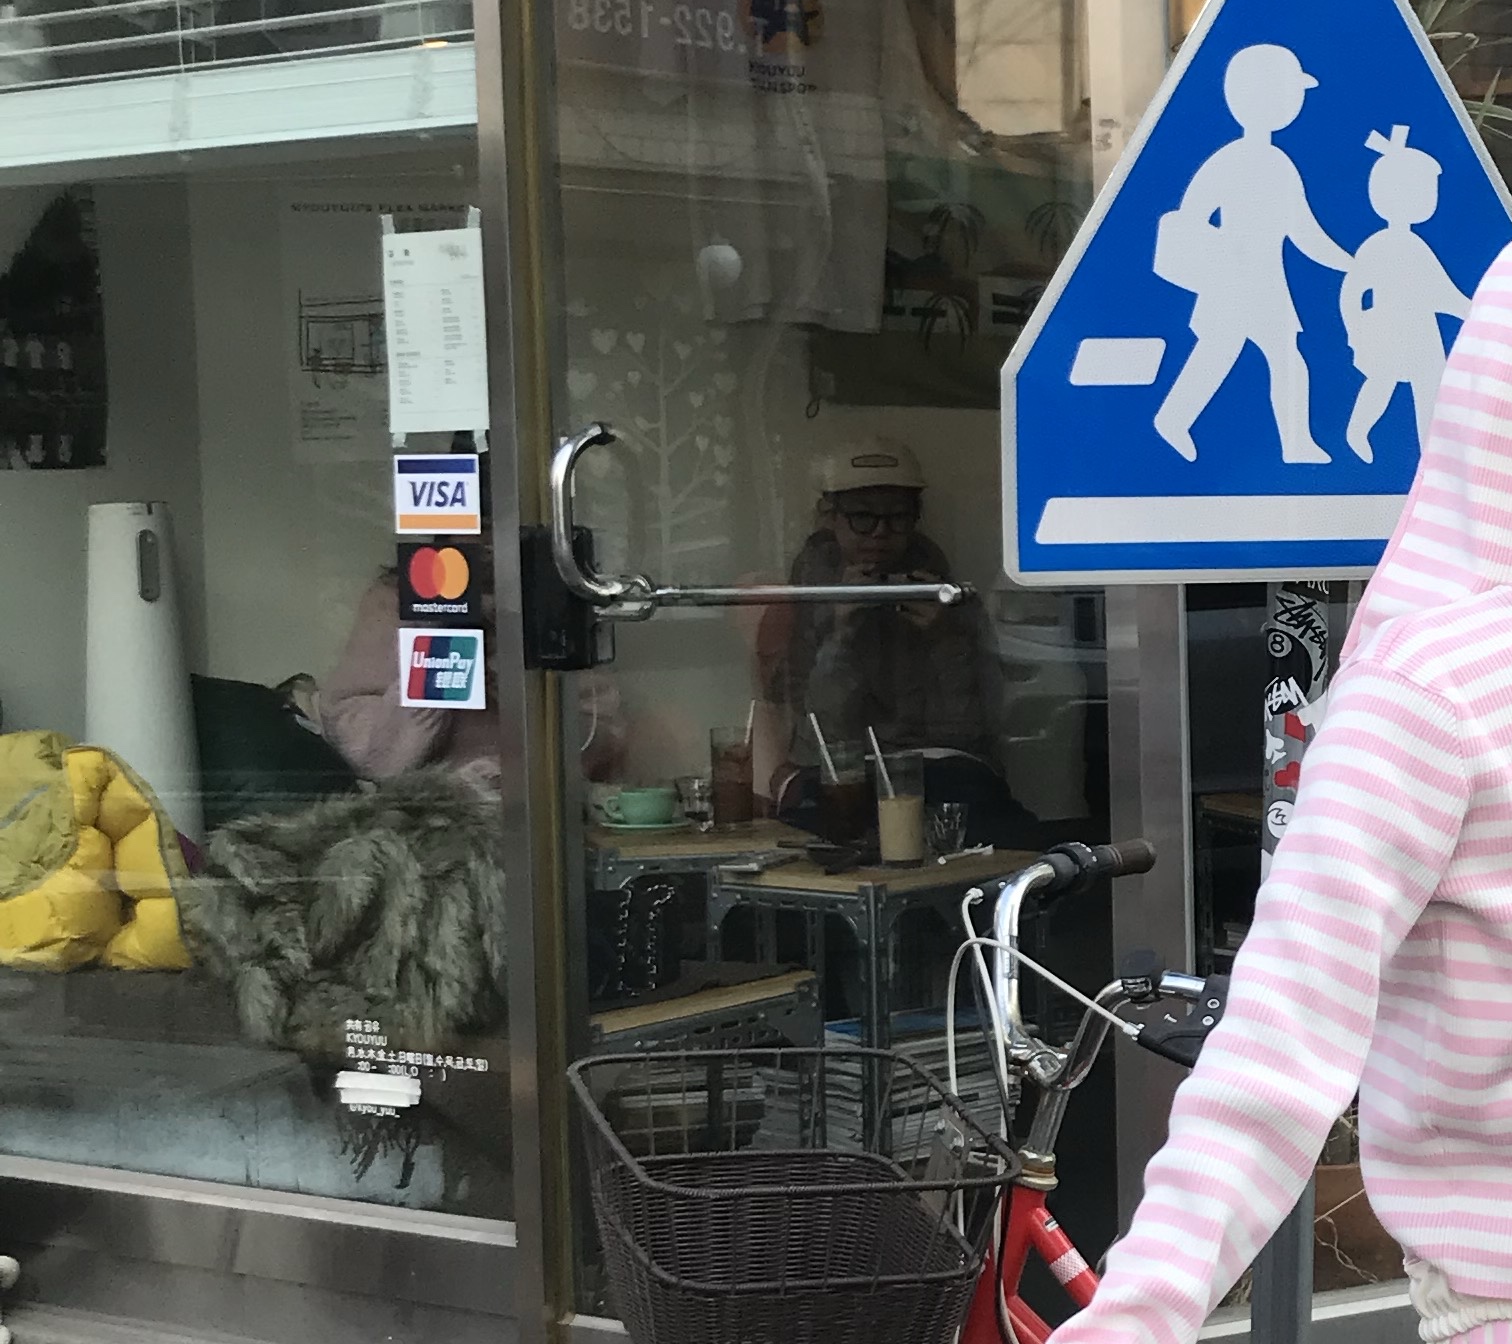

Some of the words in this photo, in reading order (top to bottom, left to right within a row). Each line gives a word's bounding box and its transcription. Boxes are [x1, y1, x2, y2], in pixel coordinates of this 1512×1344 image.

[409, 481, 467, 507] VISA
[412, 602, 469, 614] mastercard
[1270, 633, 1285, 653] 8
[413, 651, 475, 676] UnionPay
[346, 1033, 388, 1046] KYOUYUU
